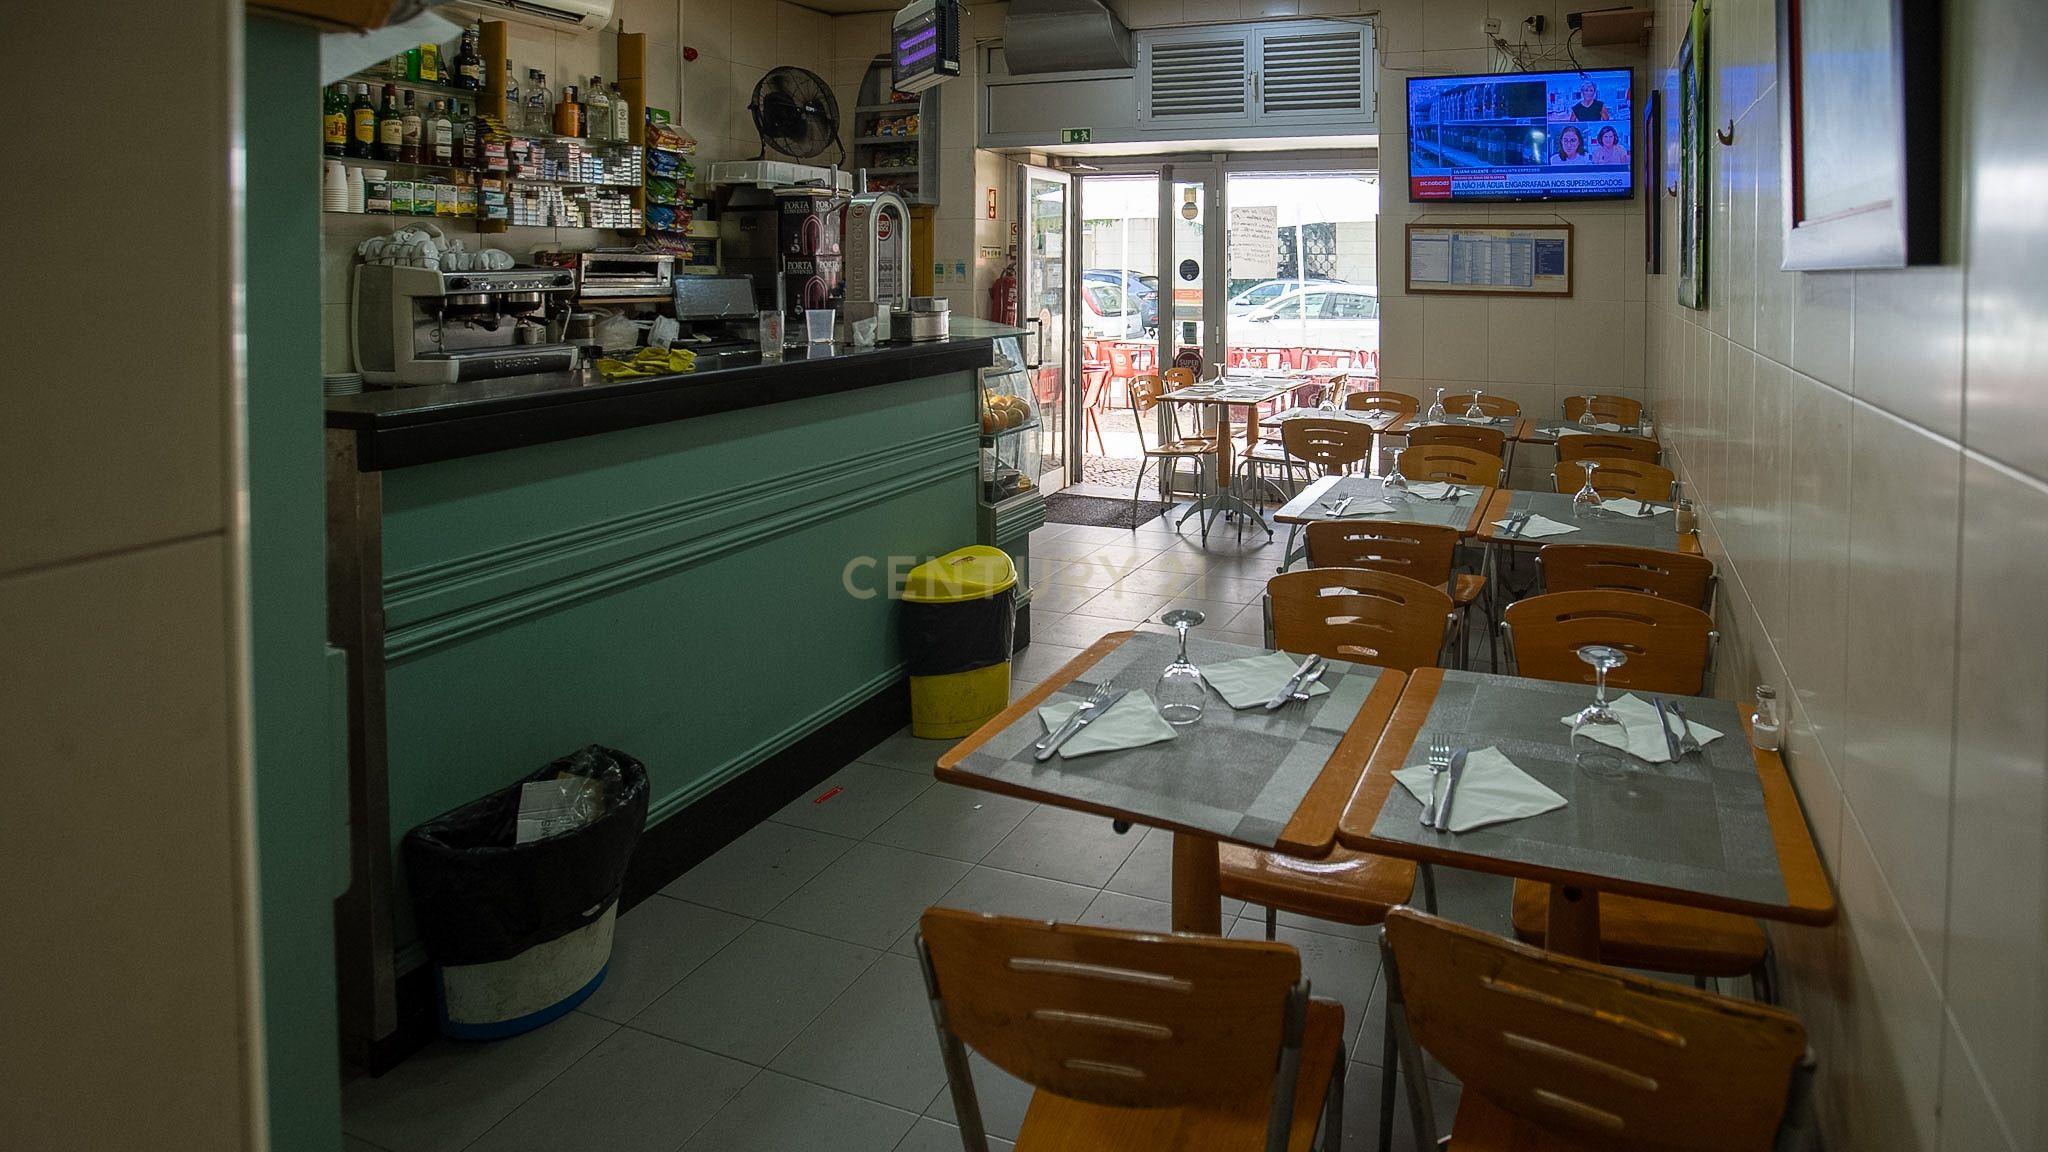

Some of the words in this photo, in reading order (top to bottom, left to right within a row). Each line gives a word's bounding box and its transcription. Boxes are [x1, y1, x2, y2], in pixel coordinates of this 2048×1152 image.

[1505, 180, 1550, 189] ENGARRAFADA
[1551, 180, 1565, 188] NOS
[1566, 179, 1623, 188] SUPERMERCADOS
[784, 201, 809, 209] PORTA
[787, 261, 813, 269] PORTA
[1179, 358, 1200, 366] SUPER
